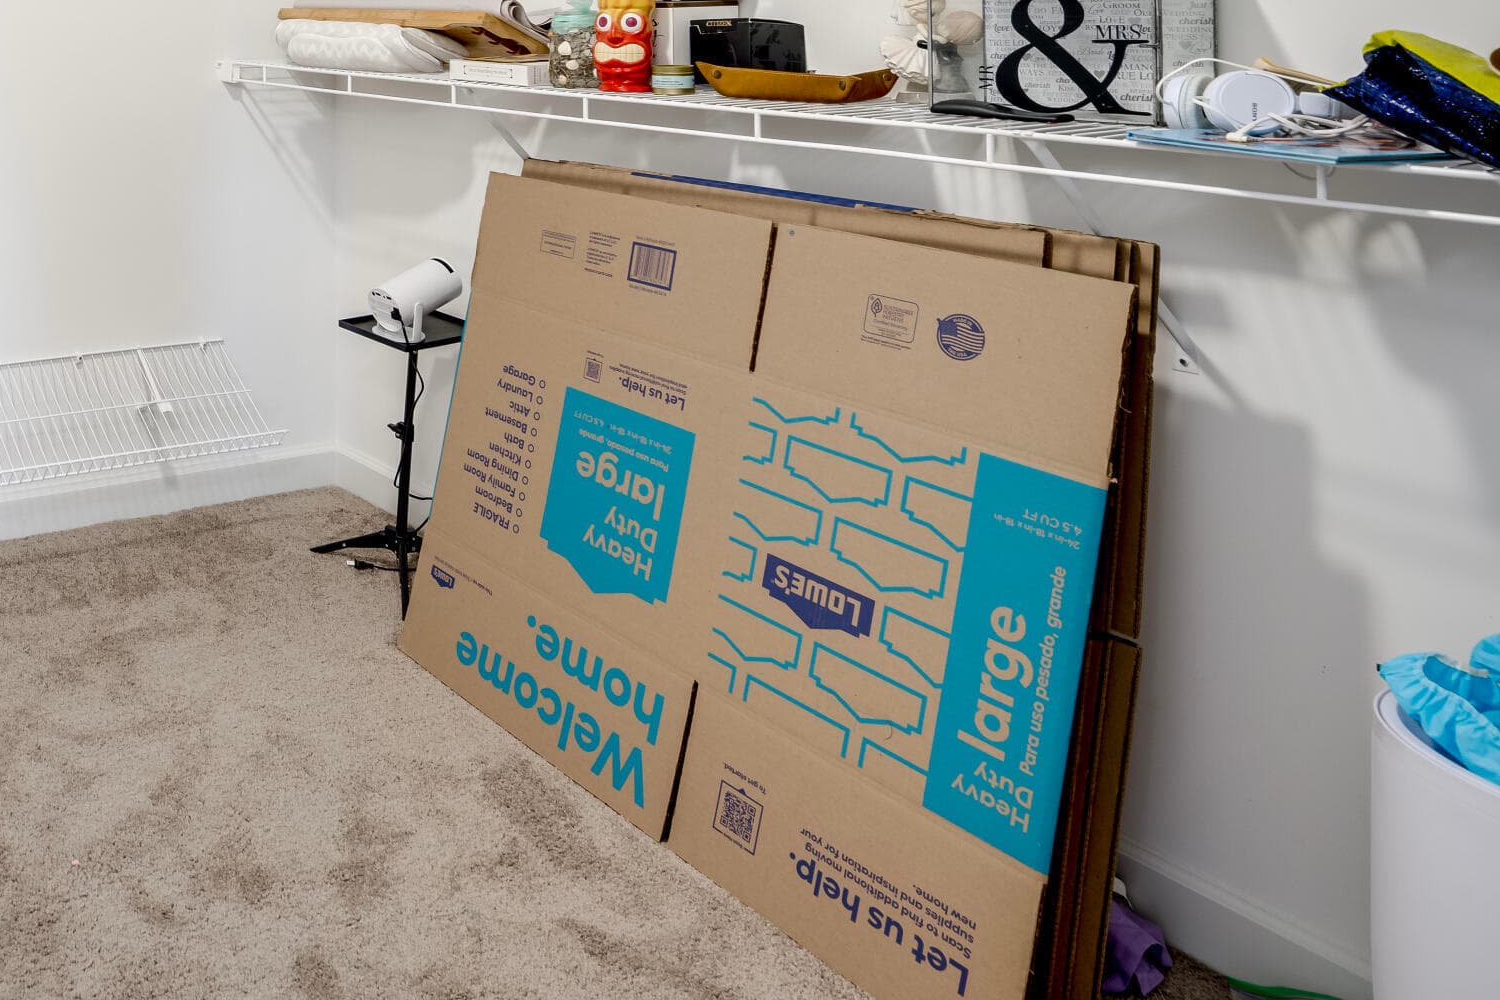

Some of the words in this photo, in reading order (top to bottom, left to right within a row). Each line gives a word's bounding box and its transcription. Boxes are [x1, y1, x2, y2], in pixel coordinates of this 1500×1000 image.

[1095, 23, 1142, 40] MRS
[503, 365, 536, 386] Garage
[618, 375, 647, 398] help.
[497, 378, 533, 402] Laundry
[649, 387, 663, 400] us
[665, 393, 686, 411] Let
[485, 407, 527, 433] Basement
[509, 401, 530, 417] Attic
[489, 442, 522, 466] Kitchen
[504, 432, 525, 450] Bath
[467, 448, 490, 468] Room
[491, 459, 519, 482] Dining
[463, 463, 487, 483] Room
[576, 451, 666, 521] large
[475, 485, 513, 514] Bedroom
[487, 476, 516, 498] Family
[473, 502, 510, 530] FRAGILE
[1023, 508, 1038, 521] FT
[1040, 513, 1060, 529] CU
[604, 505, 658, 554] Duty
[1062, 521, 1083, 537] 4.5
[582, 524, 653, 582] Heavy
[774, 565, 862, 628] LOWE'S
[1046, 565, 1068, 629] grande
[1035, 632, 1060, 702] pesado,
[527, 615, 665, 746] home.
[957, 606, 1034, 762] large
[456, 631, 644, 809] Welcome
[1029, 701, 1045, 732] uso
[1019, 737, 1041, 776] Para
[973, 761, 1034, 810] Duty
[951, 773, 1031, 834] Heavy
[799, 827, 823, 847] your
[804, 842, 842, 873] moving
[825, 842, 840, 859] for
[840, 852, 899, 896] inspiration
[789, 852, 860, 923] help.
[843, 868, 900, 911] additional
[912, 883, 949, 915] home.
[900, 890, 923, 913] and
[867, 905, 904, 945] us
[901, 906, 924, 930] find
[925, 906, 975, 944] supplies
[926, 923, 939, 938] to
[950, 909, 977, 931] new
[945, 938, 973, 960] Scan
[911, 934, 969, 997] Let
